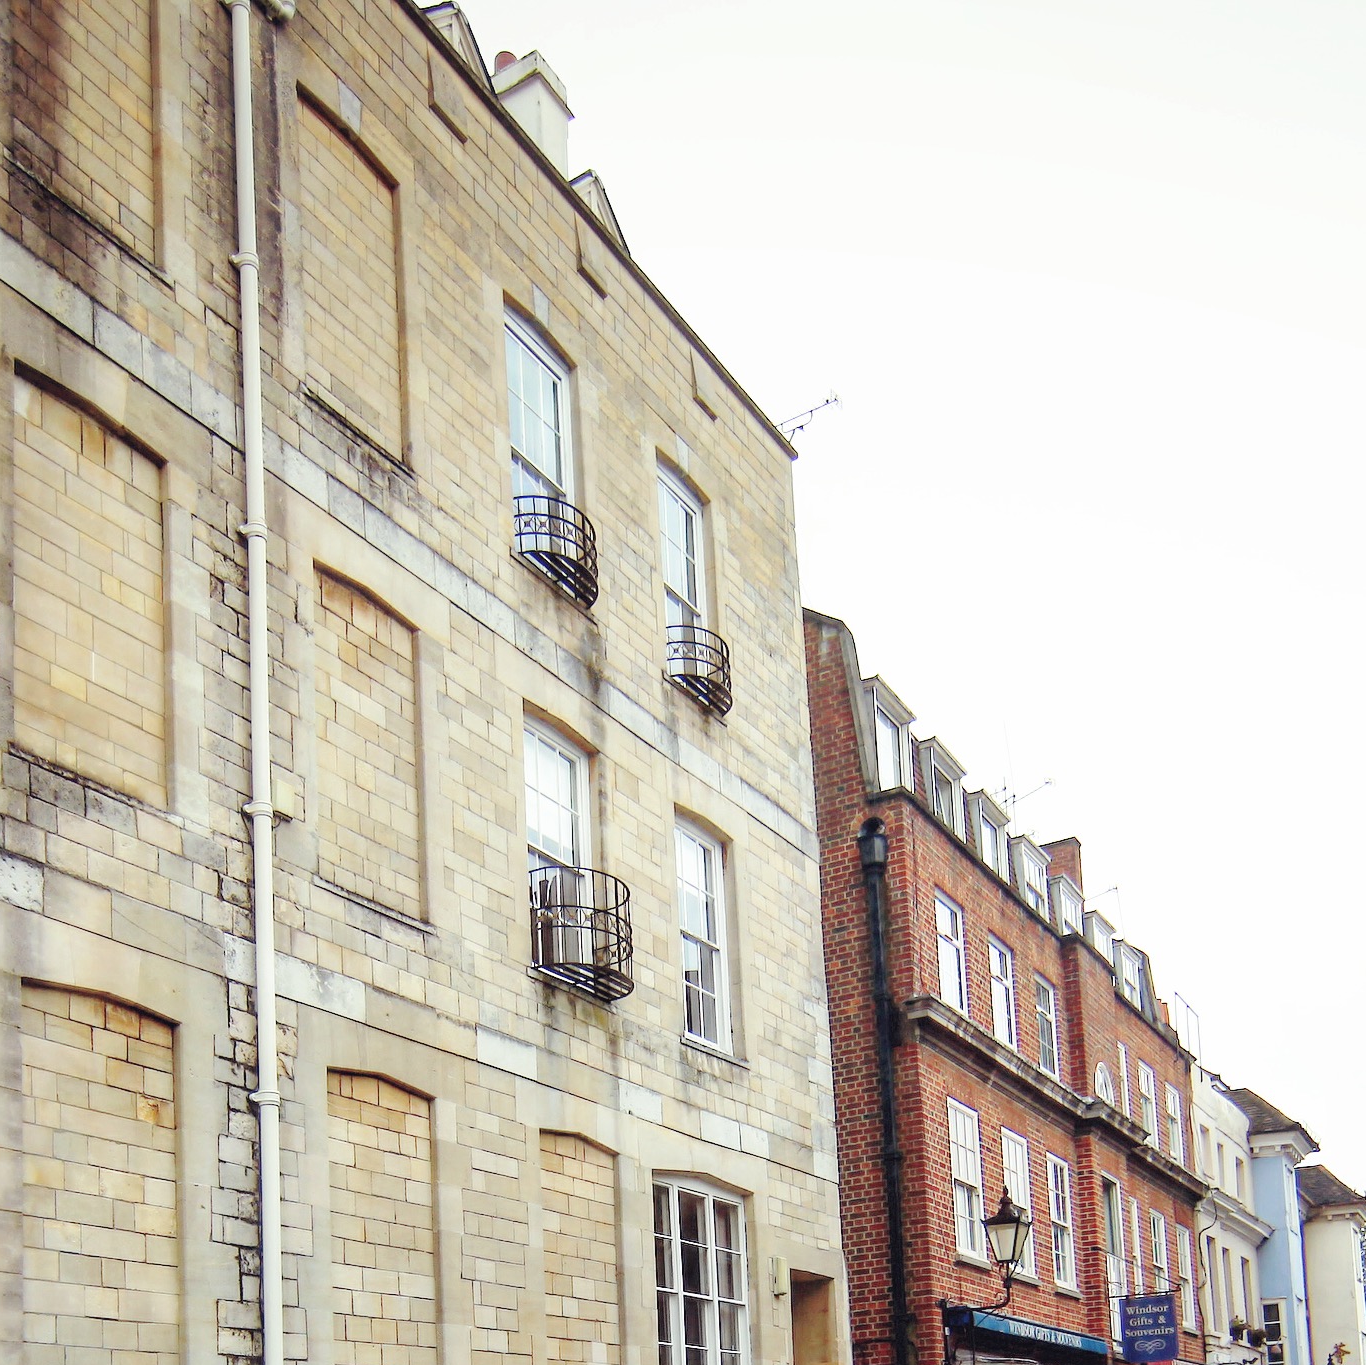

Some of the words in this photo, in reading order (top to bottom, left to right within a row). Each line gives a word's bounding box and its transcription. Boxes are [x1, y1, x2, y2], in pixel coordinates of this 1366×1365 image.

[1126, 1305, 1169, 1315] Windsor
[1129, 1316, 1153, 1327] Gifts
[1158, 1315, 1166, 1324] &
[1125, 1326, 1175, 1337] Souvenirs
